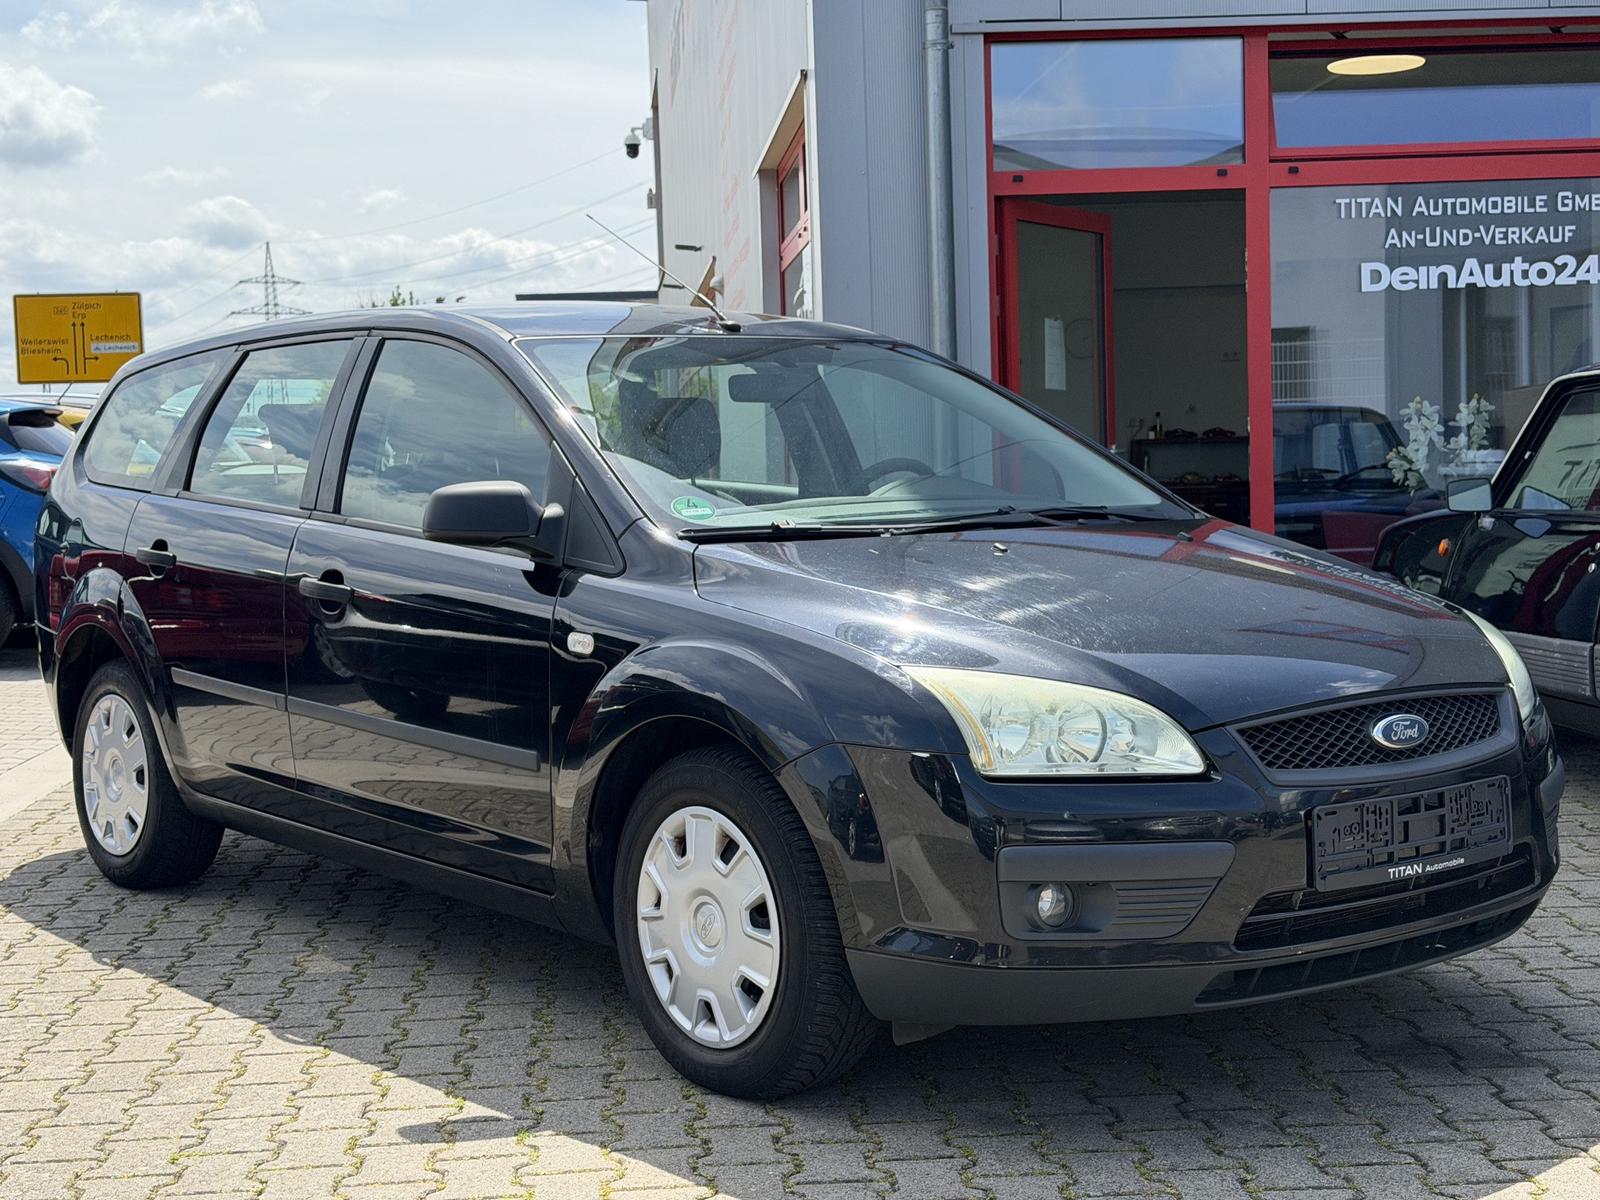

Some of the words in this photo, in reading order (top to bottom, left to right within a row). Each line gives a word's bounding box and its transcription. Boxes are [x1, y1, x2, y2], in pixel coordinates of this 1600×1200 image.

[1335, 197, 1403, 219] TITAN
[1360, 254, 1600, 293] DeinAuto24
[71, 301, 102, 311] Zülpich
[72, 311, 87, 320] Erp
[90, 333, 132, 342] Lechenich
[1391, 720, 1420, 741] Ford
[1388, 863, 1423, 879] TITAN
[1425, 856, 1465, 872] Automobile
